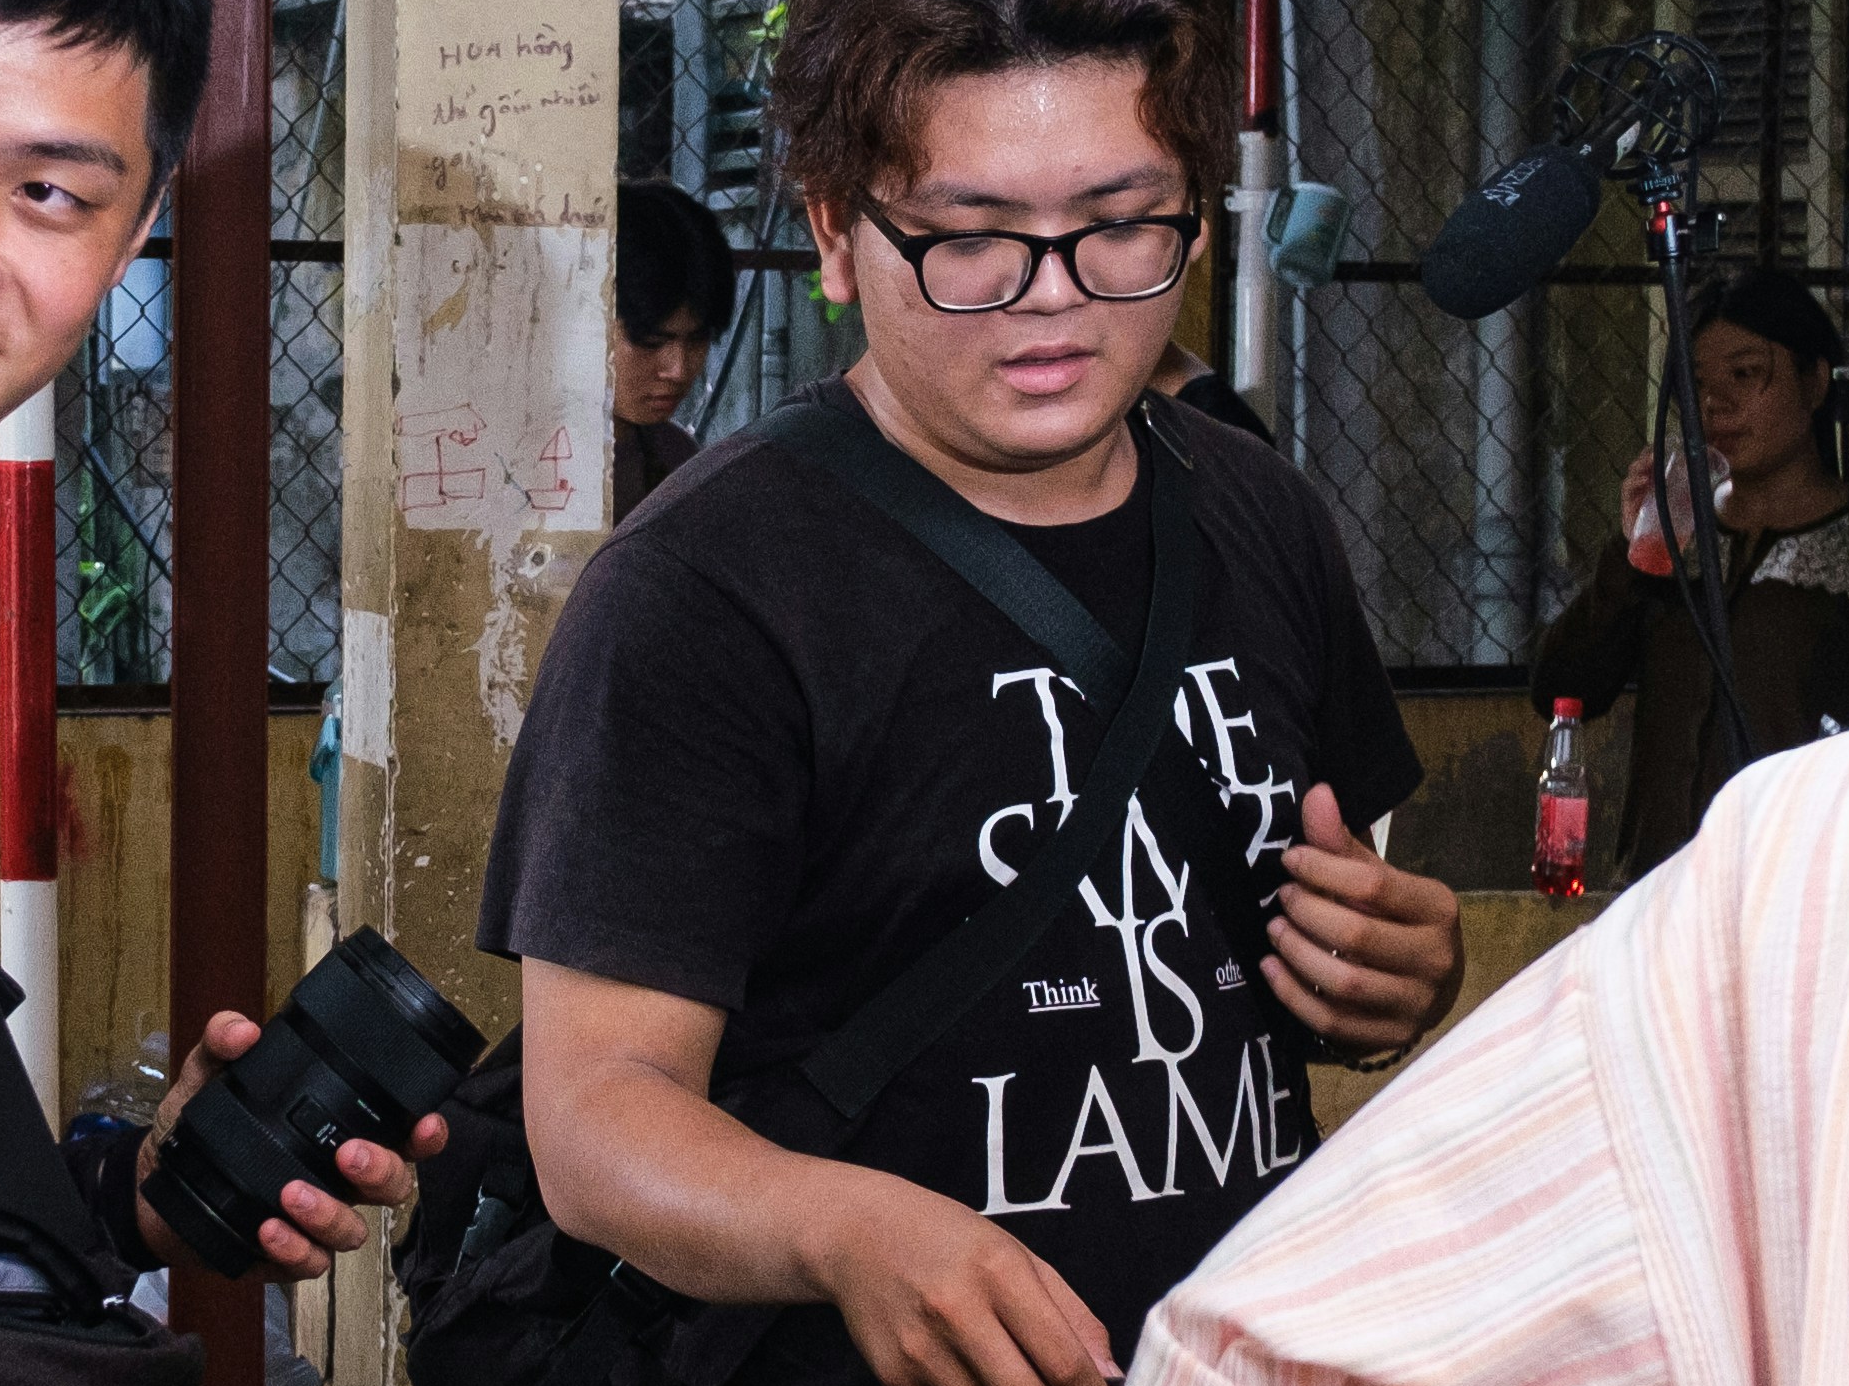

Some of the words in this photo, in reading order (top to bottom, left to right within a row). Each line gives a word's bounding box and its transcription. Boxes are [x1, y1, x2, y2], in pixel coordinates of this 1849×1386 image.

[1022, 977, 1101, 1009] Think
[1117, 909, 1203, 1065] IS
[971, 1033, 1301, 1216] LAME
